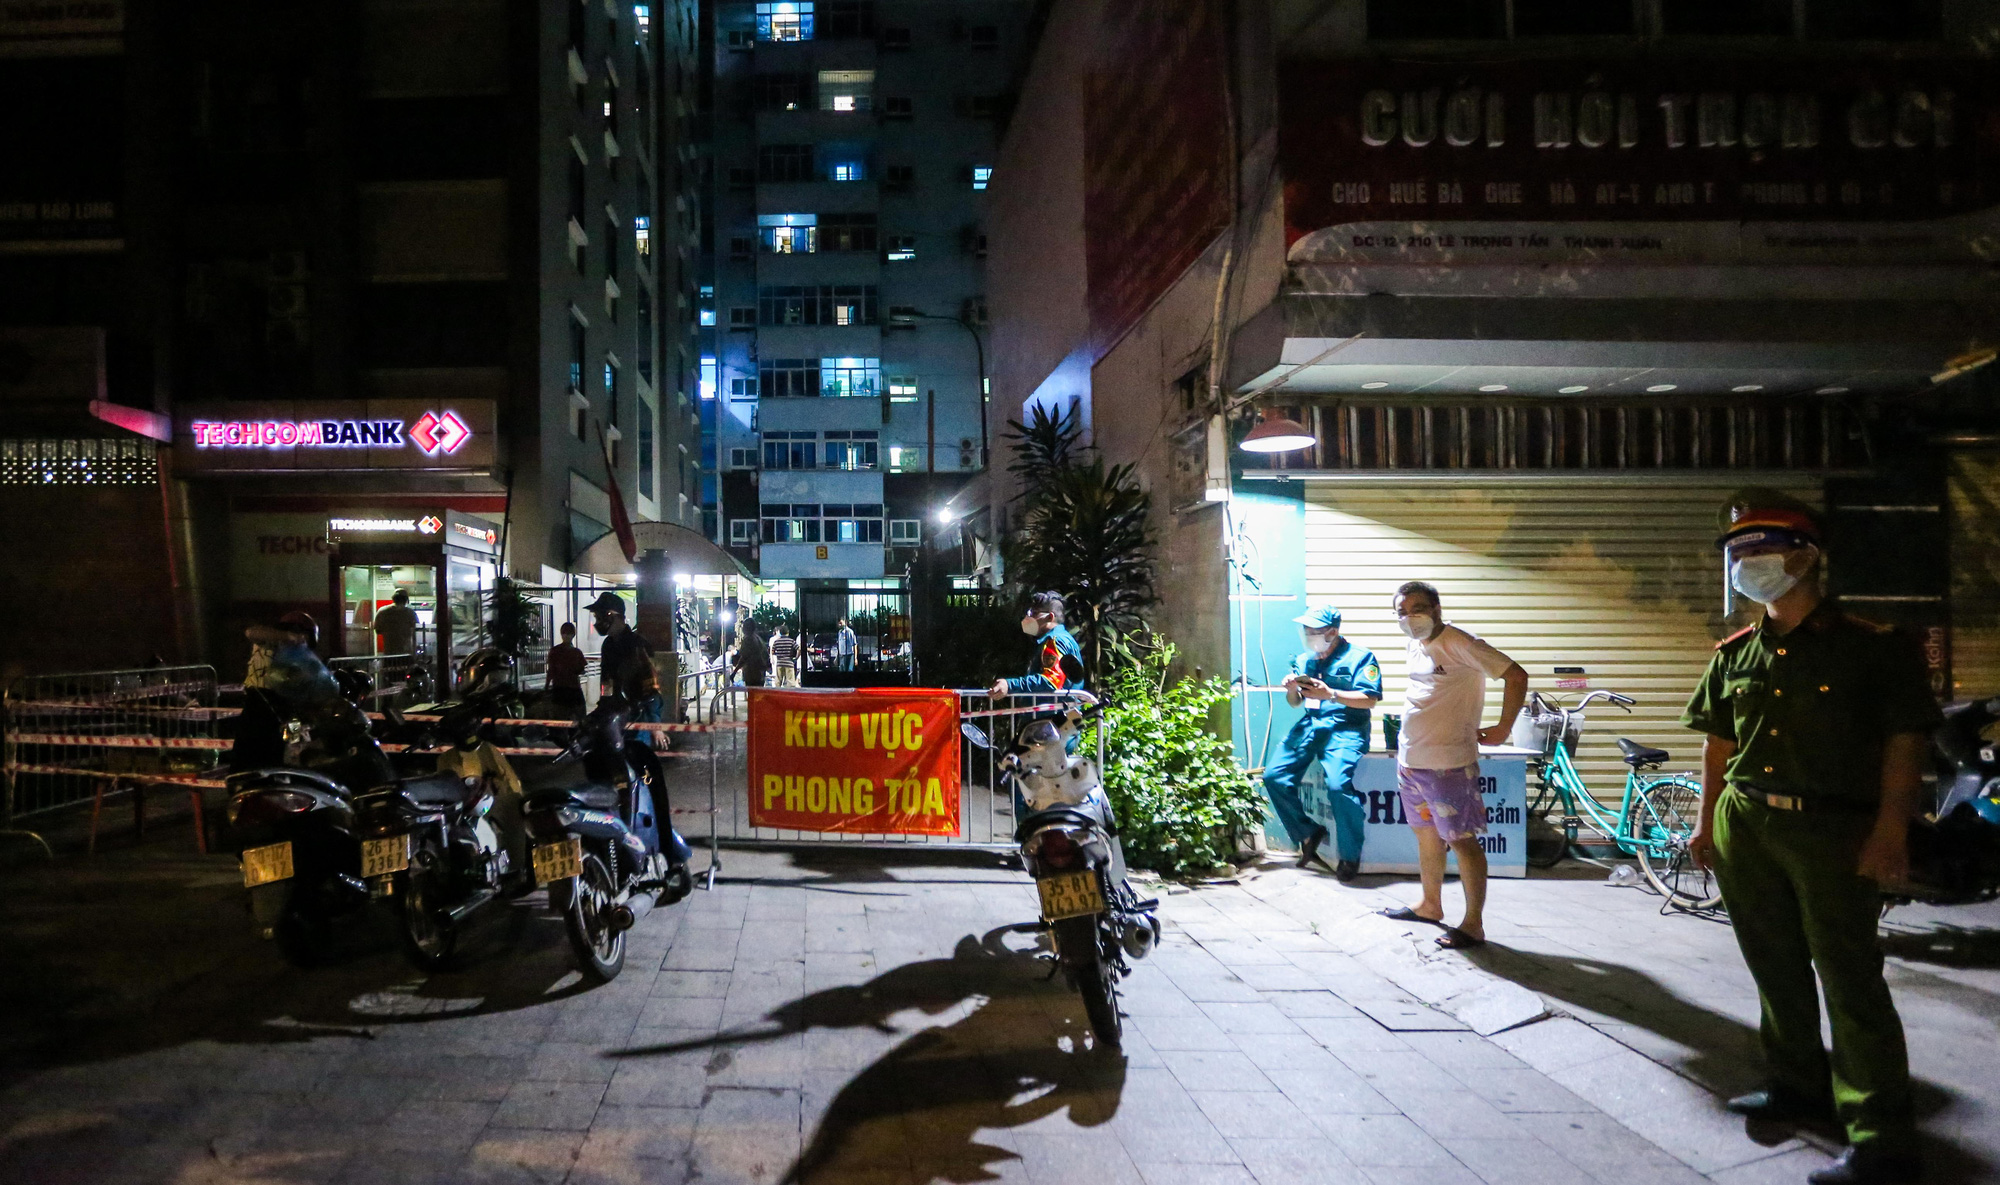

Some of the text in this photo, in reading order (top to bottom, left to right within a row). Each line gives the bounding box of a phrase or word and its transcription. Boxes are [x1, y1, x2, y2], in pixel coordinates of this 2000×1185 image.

[1332, 182, 1371, 203] CHO
[1408, 236, 1432, 248] 210
[191, 420, 404, 447] TECHCOMBANK
[817, 547, 827, 559] B
[784, 708, 924, 759] KHU VỰC
[763, 766, 945, 816] PHONG TỎA
[1479, 776, 1497, 794] en
[1478, 833, 1507, 854] anh
